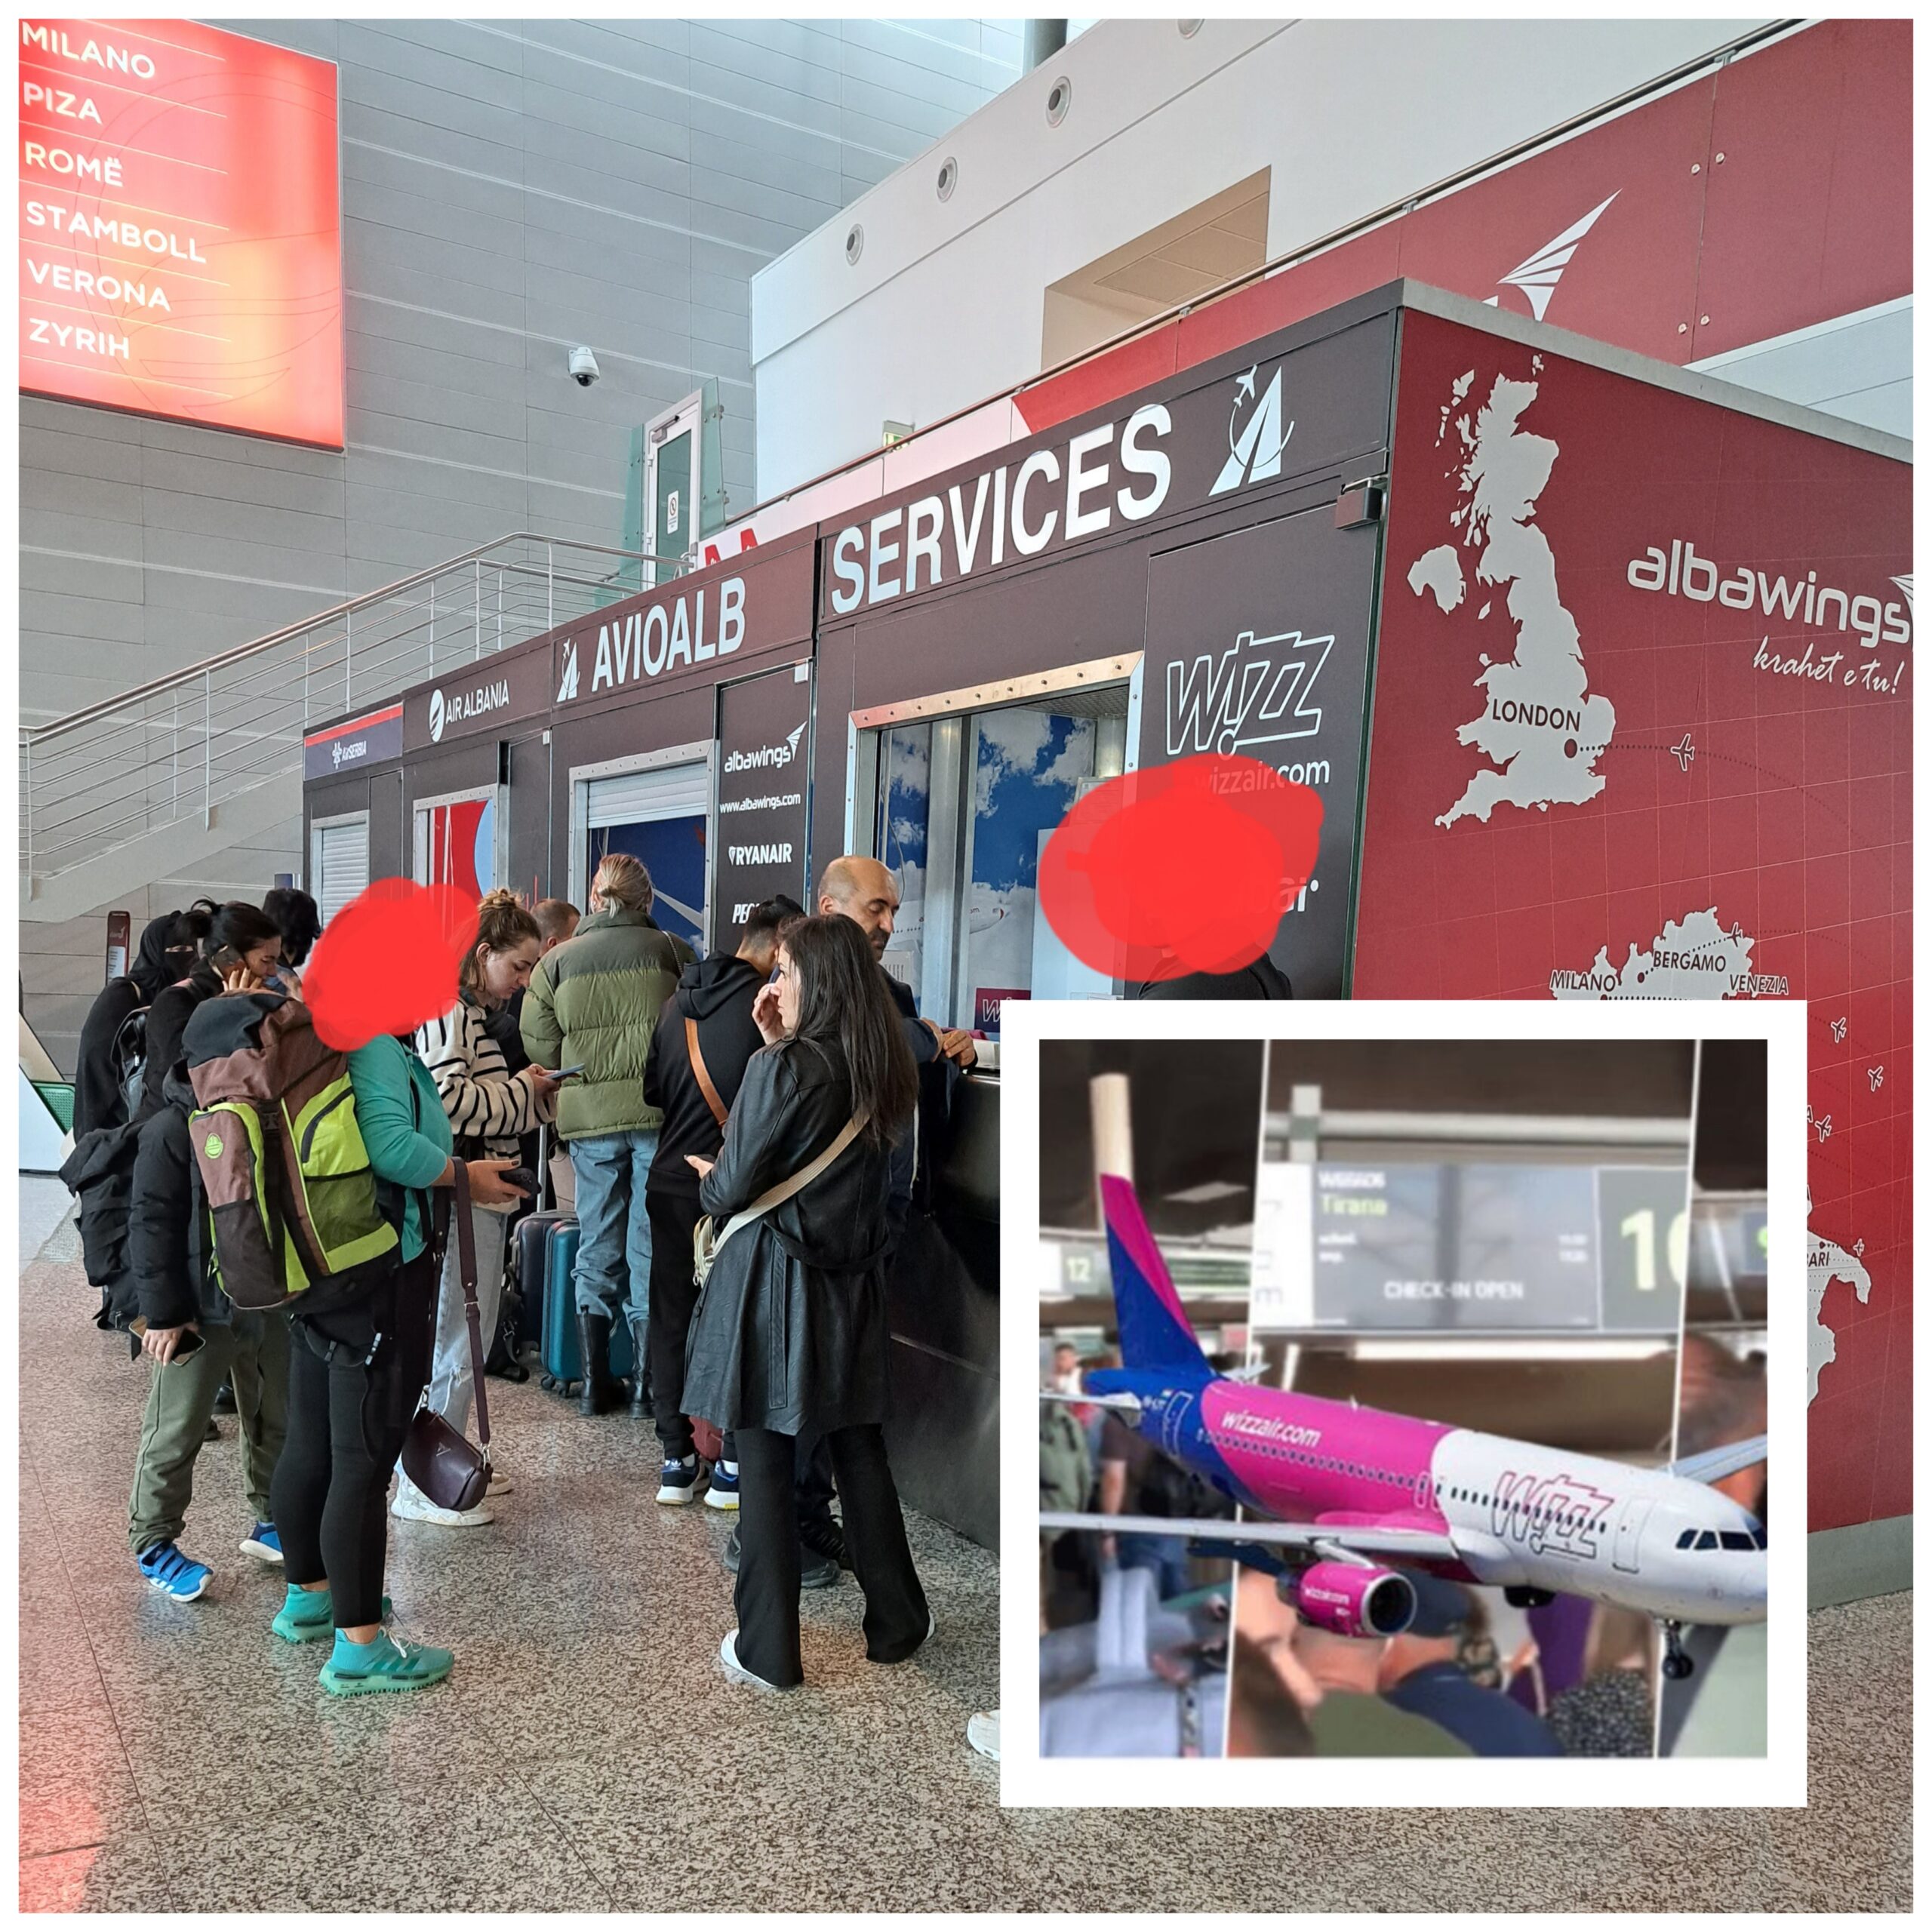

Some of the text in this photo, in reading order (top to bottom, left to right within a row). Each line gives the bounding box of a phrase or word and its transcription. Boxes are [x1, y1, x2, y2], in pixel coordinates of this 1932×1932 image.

[22, 21, 155, 78] MILANO
[23, 82, 102, 124] PIZA
[25, 142, 123, 187] ROMË
[26, 202, 206, 263] STAMBOLL
[26, 259, 171, 311] VERONA
[29, 318, 130, 359] ZYRIH
[591, 403, 1172, 692] AVIOALB SERVICES
[1627, 538, 1911, 649] albawings
[1844, 669, 1857, 686] e
[1860, 658, 1905, 694] tu!
[445, 679, 509, 724] AIR ALBANIA
[1492, 699, 1580, 732] LONDON
[724, 745, 791, 773] albawings
[719, 793, 801, 814] www.albawings.com
[736, 843, 792, 865] RYANAIR
[1653, 951, 1726, 972] BERGAMO
[1549, 970, 1616, 992] MILANO
[1729, 974, 1789, 995] VENEZIA
[1321, 1195, 1388, 1216] Tirana
[1068, 1257, 1091, 1282] 12
[1807, 1251, 1829, 1267] ARI
[1384, 1281, 1524, 1299] CHECK-IN OPEN
[1222, 1409, 1322, 1447] wizzair.com
